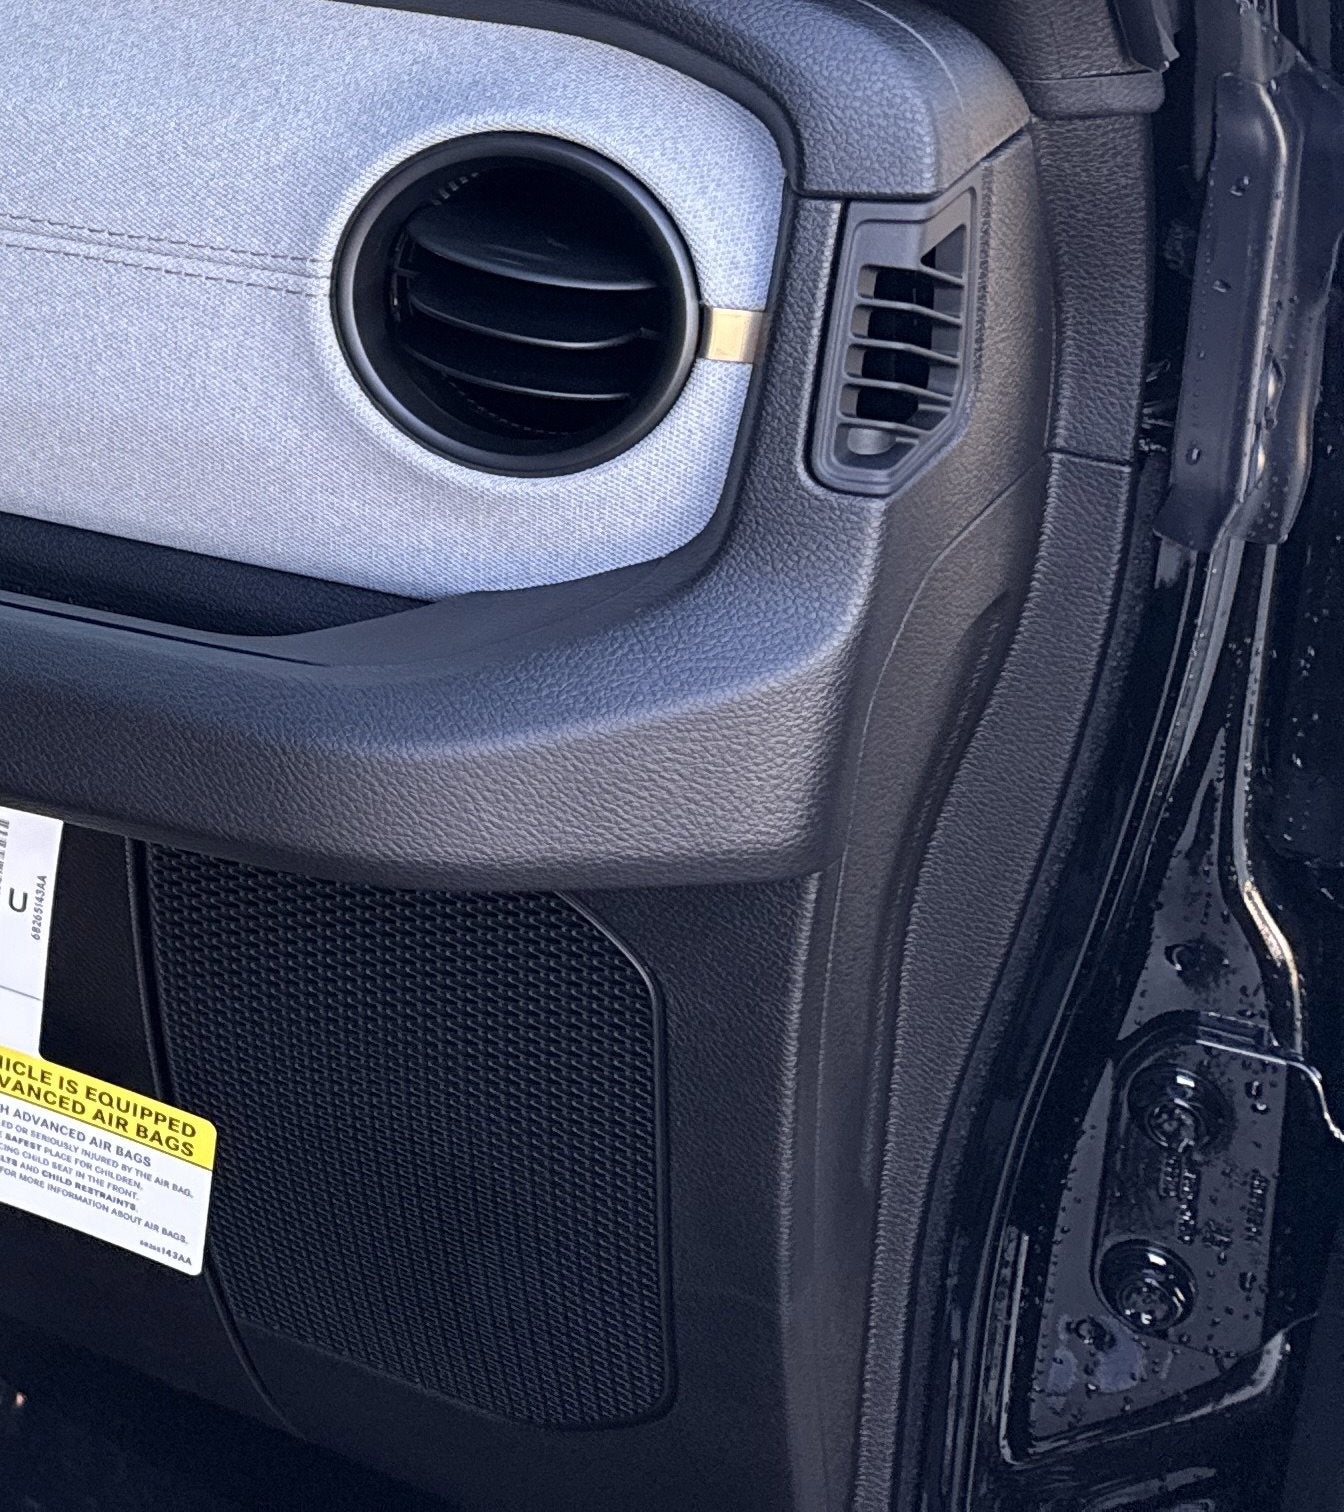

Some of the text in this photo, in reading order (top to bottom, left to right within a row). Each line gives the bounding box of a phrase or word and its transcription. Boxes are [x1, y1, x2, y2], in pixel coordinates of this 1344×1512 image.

[31, 876, 47, 941] 68265143AA
[12, 1107, 85, 1143] ADVANCED
[89, 1135, 112, 1152] AIR
[115, 1145, 151, 1167] BAGS
[58, 1075, 78, 1095] IS
[85, 1085, 196, 1139] EQUIPPED
[92, 1106, 129, 1133] AIR
[135, 1122, 195, 1158] BAGS
[4, 1132, 41, 1152] SAFEST
[43, 1146, 72, 1163] PLACE
[74, 1157, 92, 1171] FOR
[14, 1124, 28, 1136] OR
[30, 1129, 78, 1154] SERIOUSLY
[81, 1147, 119, 1168] INJURED
[120, 1162, 132, 1174] BY
[134, 1167, 152, 1181] THE
[153, 1175, 169, 1189] AIR
[19, 1161, 39, 1174] AND
[41, 1169, 72, 1187] CHILD
[21, 1150, 49, 1166] CHILD
[51, 1161, 73, 1175] SEAT
[75, 1169, 85, 1180] IN
[87, 1174, 104, 1187] THE
[18, 1172, 44, 1188] MORE
[47, 1182, 108, 1213] INFORMATION
[110, 1206, 142, 1226] ABOUT
[144, 1219, 159, 1232] AIR
